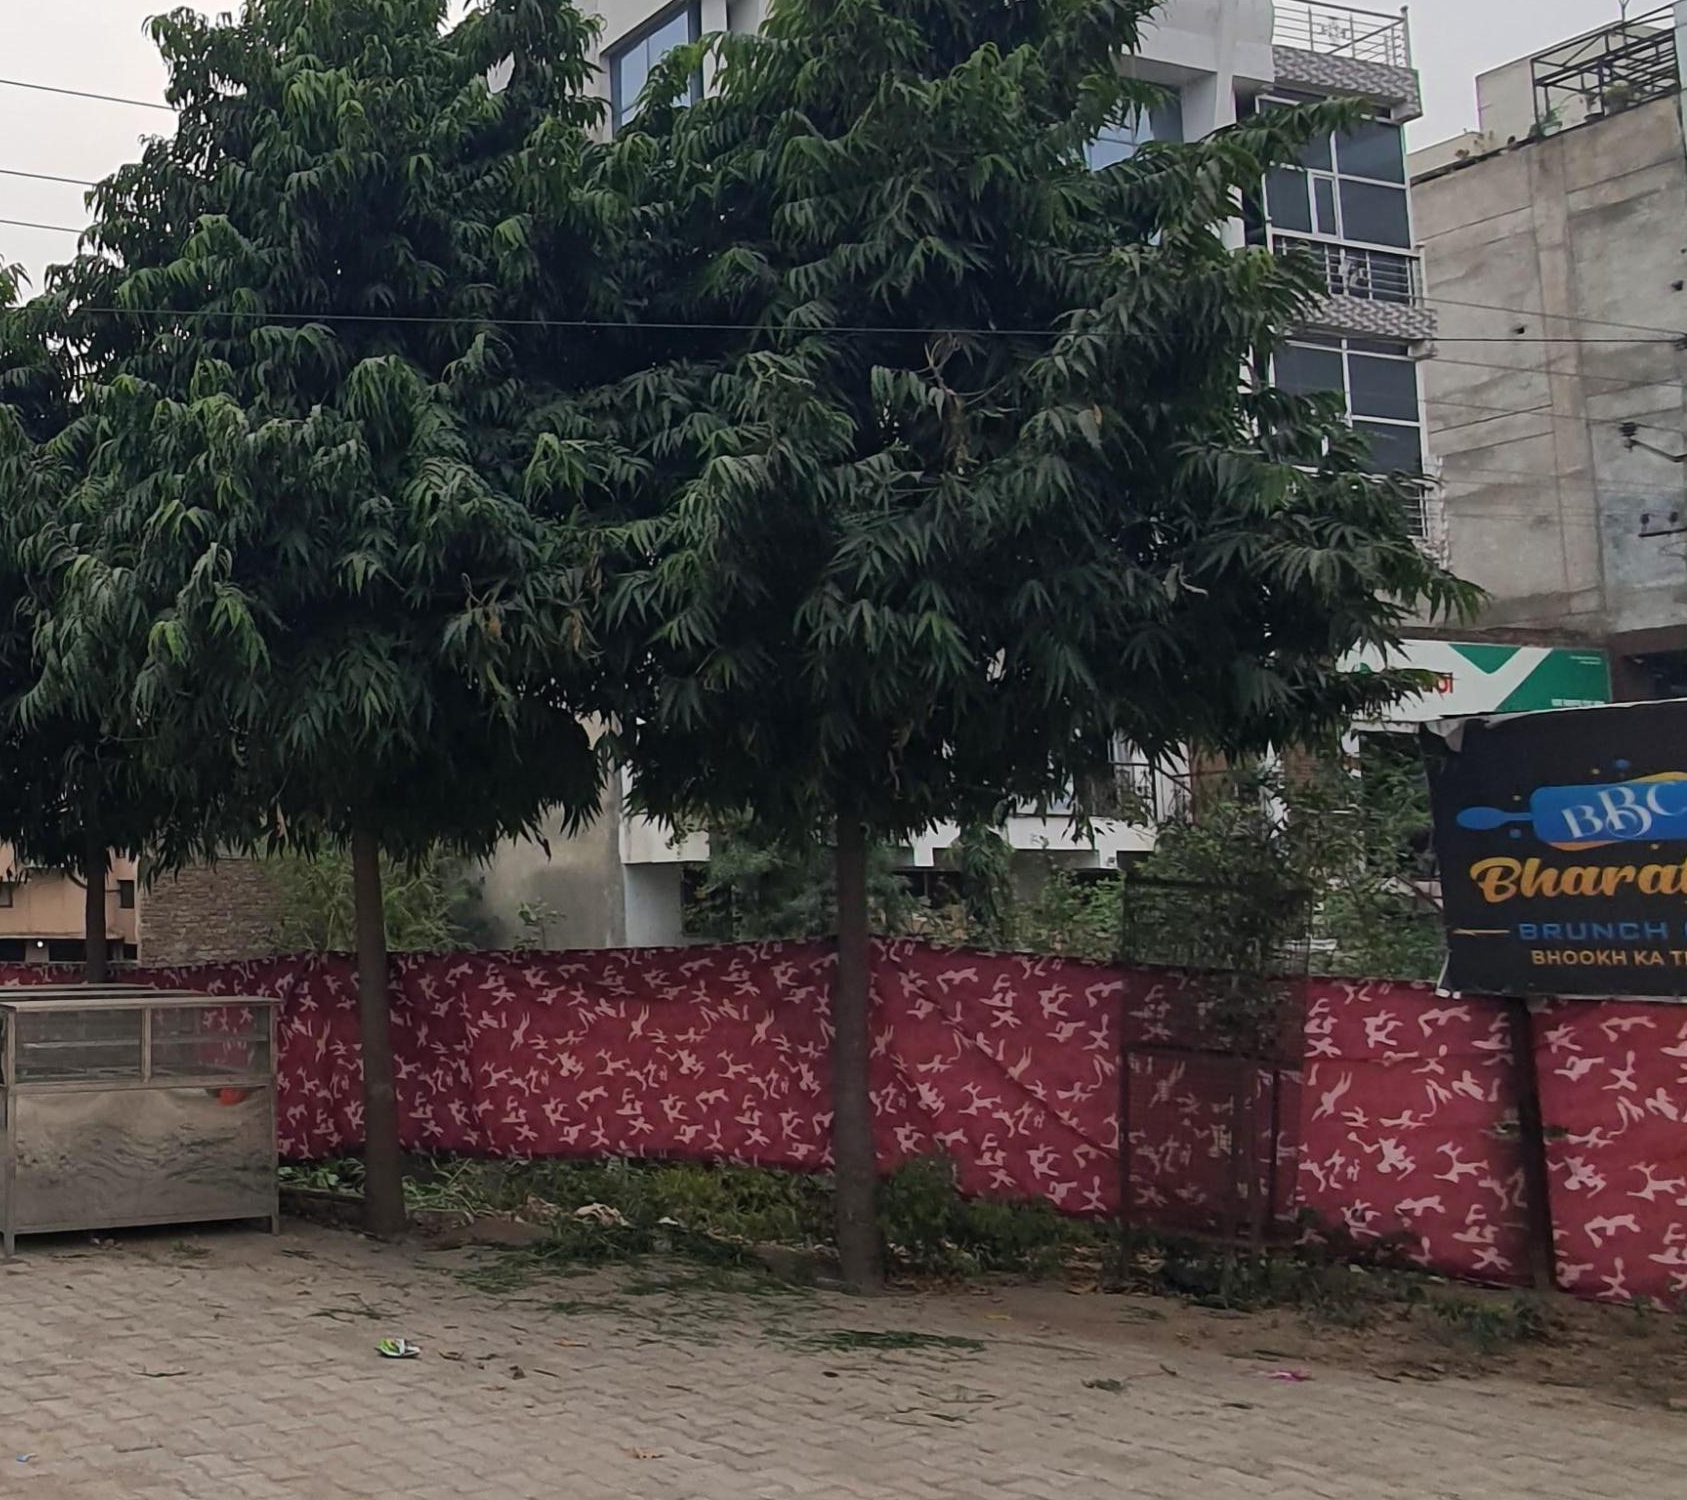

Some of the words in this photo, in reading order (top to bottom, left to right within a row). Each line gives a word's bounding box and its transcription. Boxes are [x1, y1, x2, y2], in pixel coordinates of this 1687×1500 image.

[1518, 921, 1669, 941] BRUNCH
[1531, 949, 1628, 966] BHOOKH
[1634, 950, 1665, 966] KA
